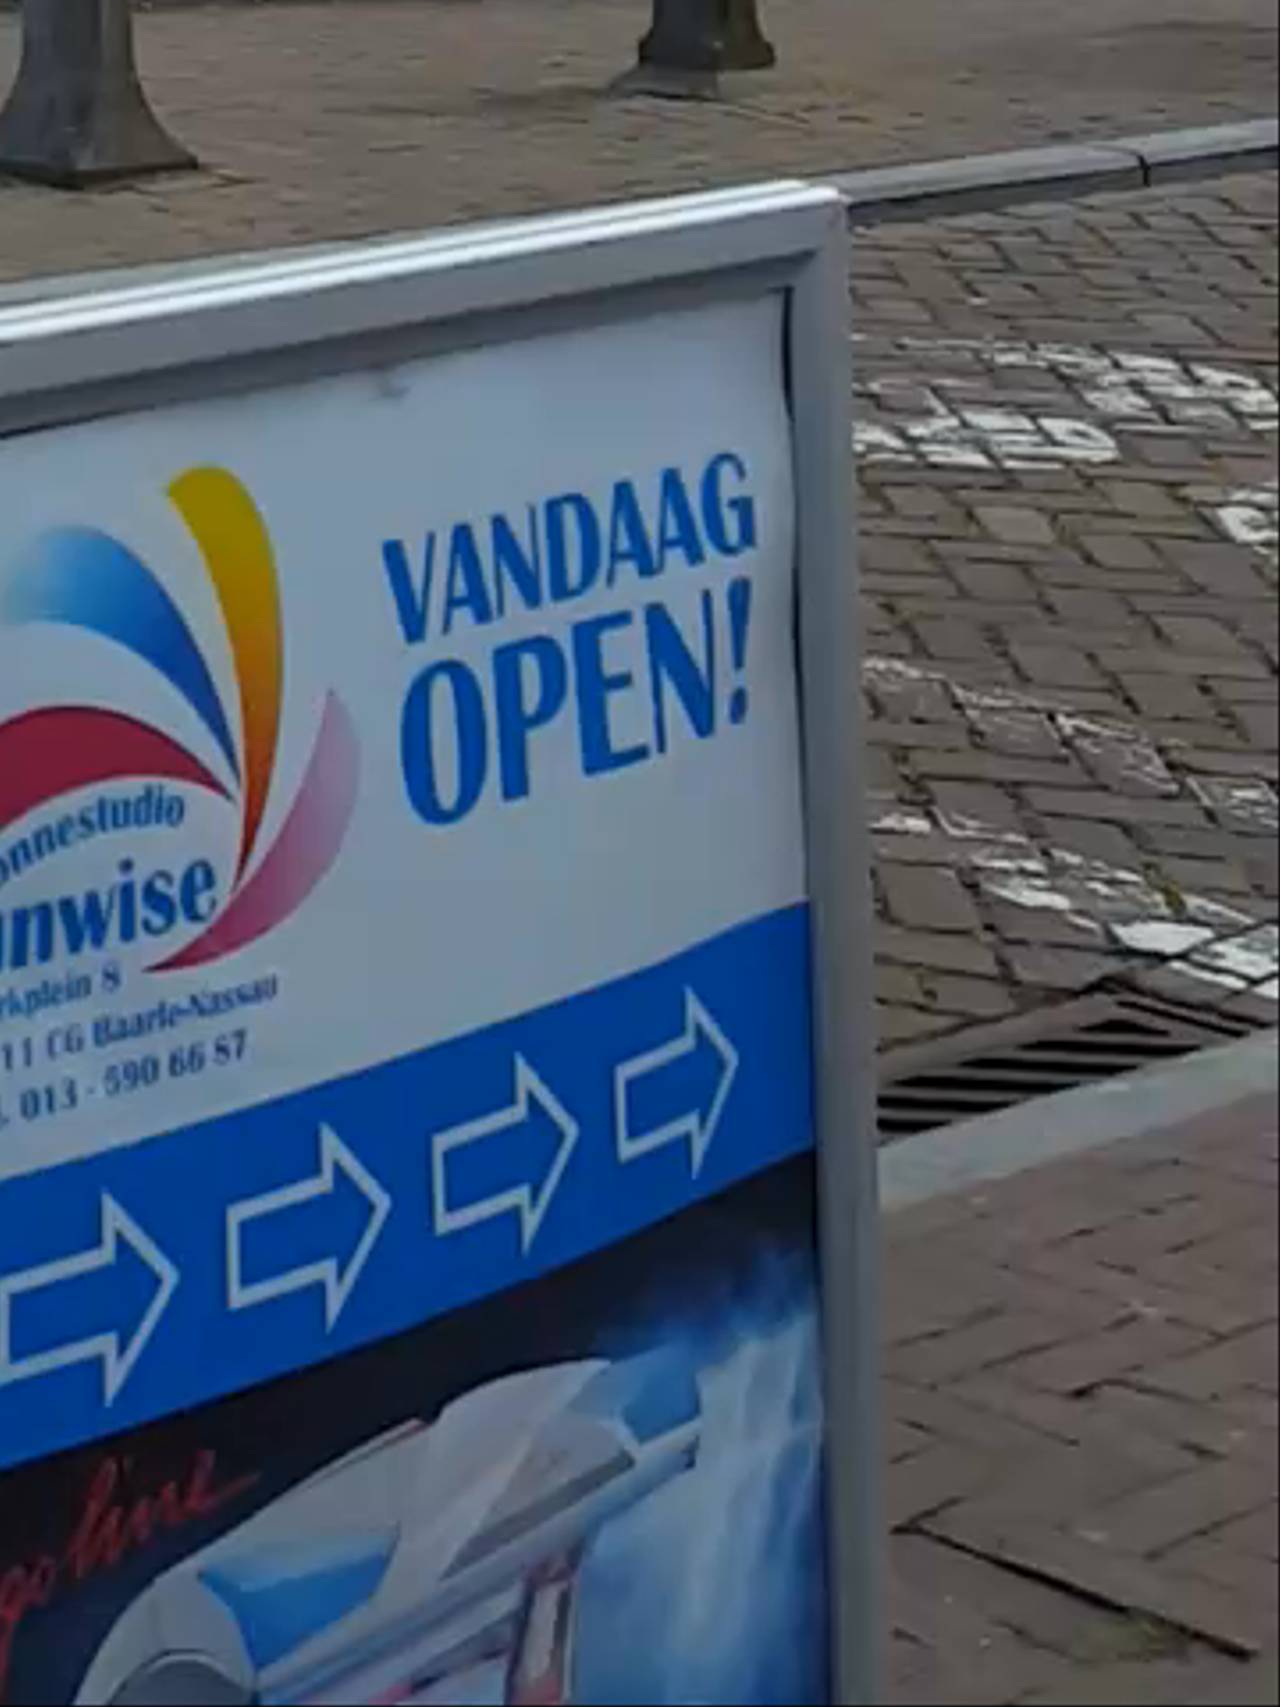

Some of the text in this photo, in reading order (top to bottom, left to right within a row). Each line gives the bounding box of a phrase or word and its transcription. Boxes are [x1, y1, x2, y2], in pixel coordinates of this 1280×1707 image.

[382, 452, 756, 645] VANDAAG
[400, 577, 752, 825] OPEN!
[92, 975, 279, 1048] Baarle-Nassau
[19, 1080, 79, 1123] 013
